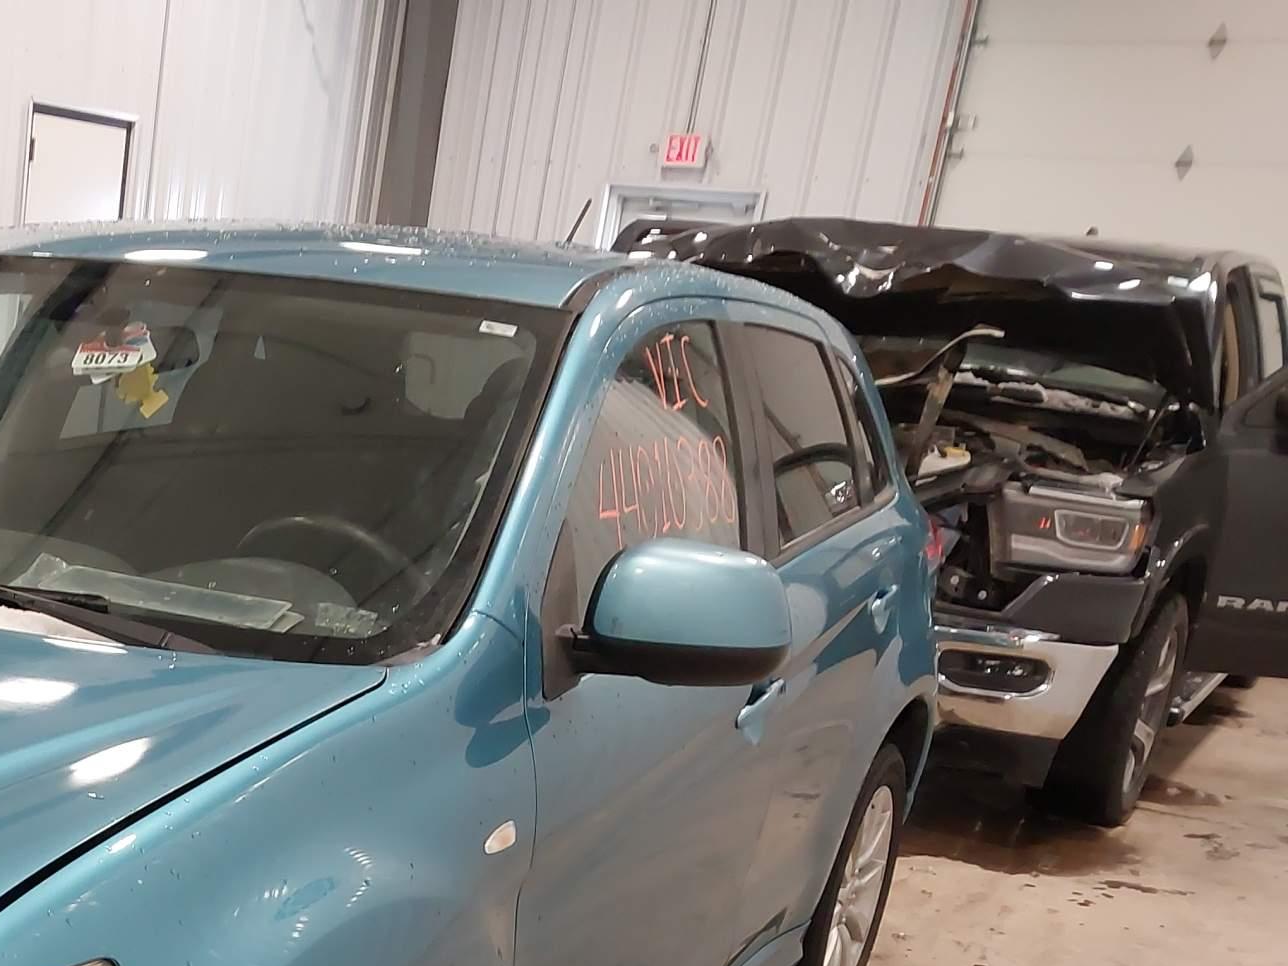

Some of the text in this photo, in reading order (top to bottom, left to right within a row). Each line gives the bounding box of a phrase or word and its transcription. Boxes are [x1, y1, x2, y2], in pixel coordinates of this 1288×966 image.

[665, 135, 701, 162] EXIT
[83, 352, 129, 365] 8073
[646, 333, 708, 411] VIC
[599, 435, 736, 549] 44010388
